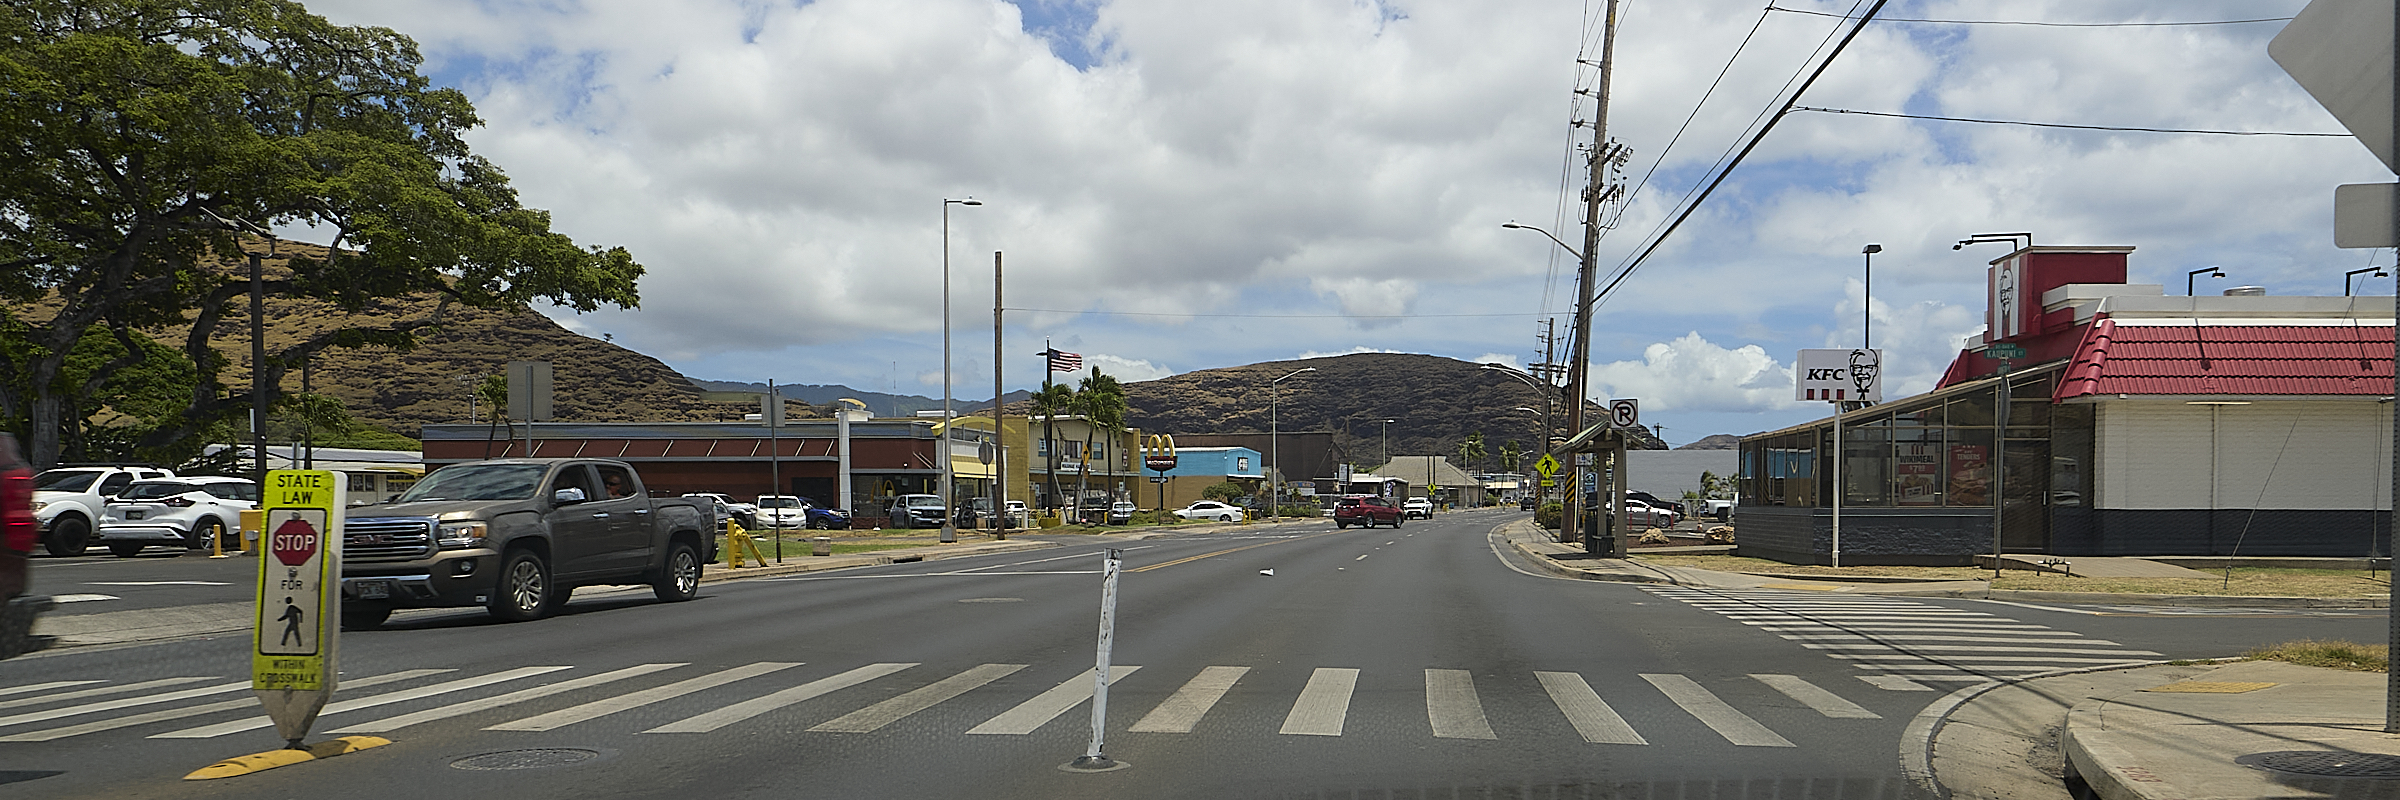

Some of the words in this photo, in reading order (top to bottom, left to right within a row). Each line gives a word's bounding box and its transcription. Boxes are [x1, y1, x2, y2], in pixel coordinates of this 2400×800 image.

[1986, 349, 2016, 358] KAUPUNI
[1806, 368, 1845, 380] KFC
[1900, 455, 1935, 463] WIKIMEAL
[277, 474, 322, 488] STATE
[282, 491, 313, 504] LAW
[275, 534, 316, 551] STOP
[353, 534, 394, 544] GMC
[281, 579, 304, 590] FOR
[272, 659, 305, 669] WITHIN
[259, 672, 316, 684] CROSSWALK
